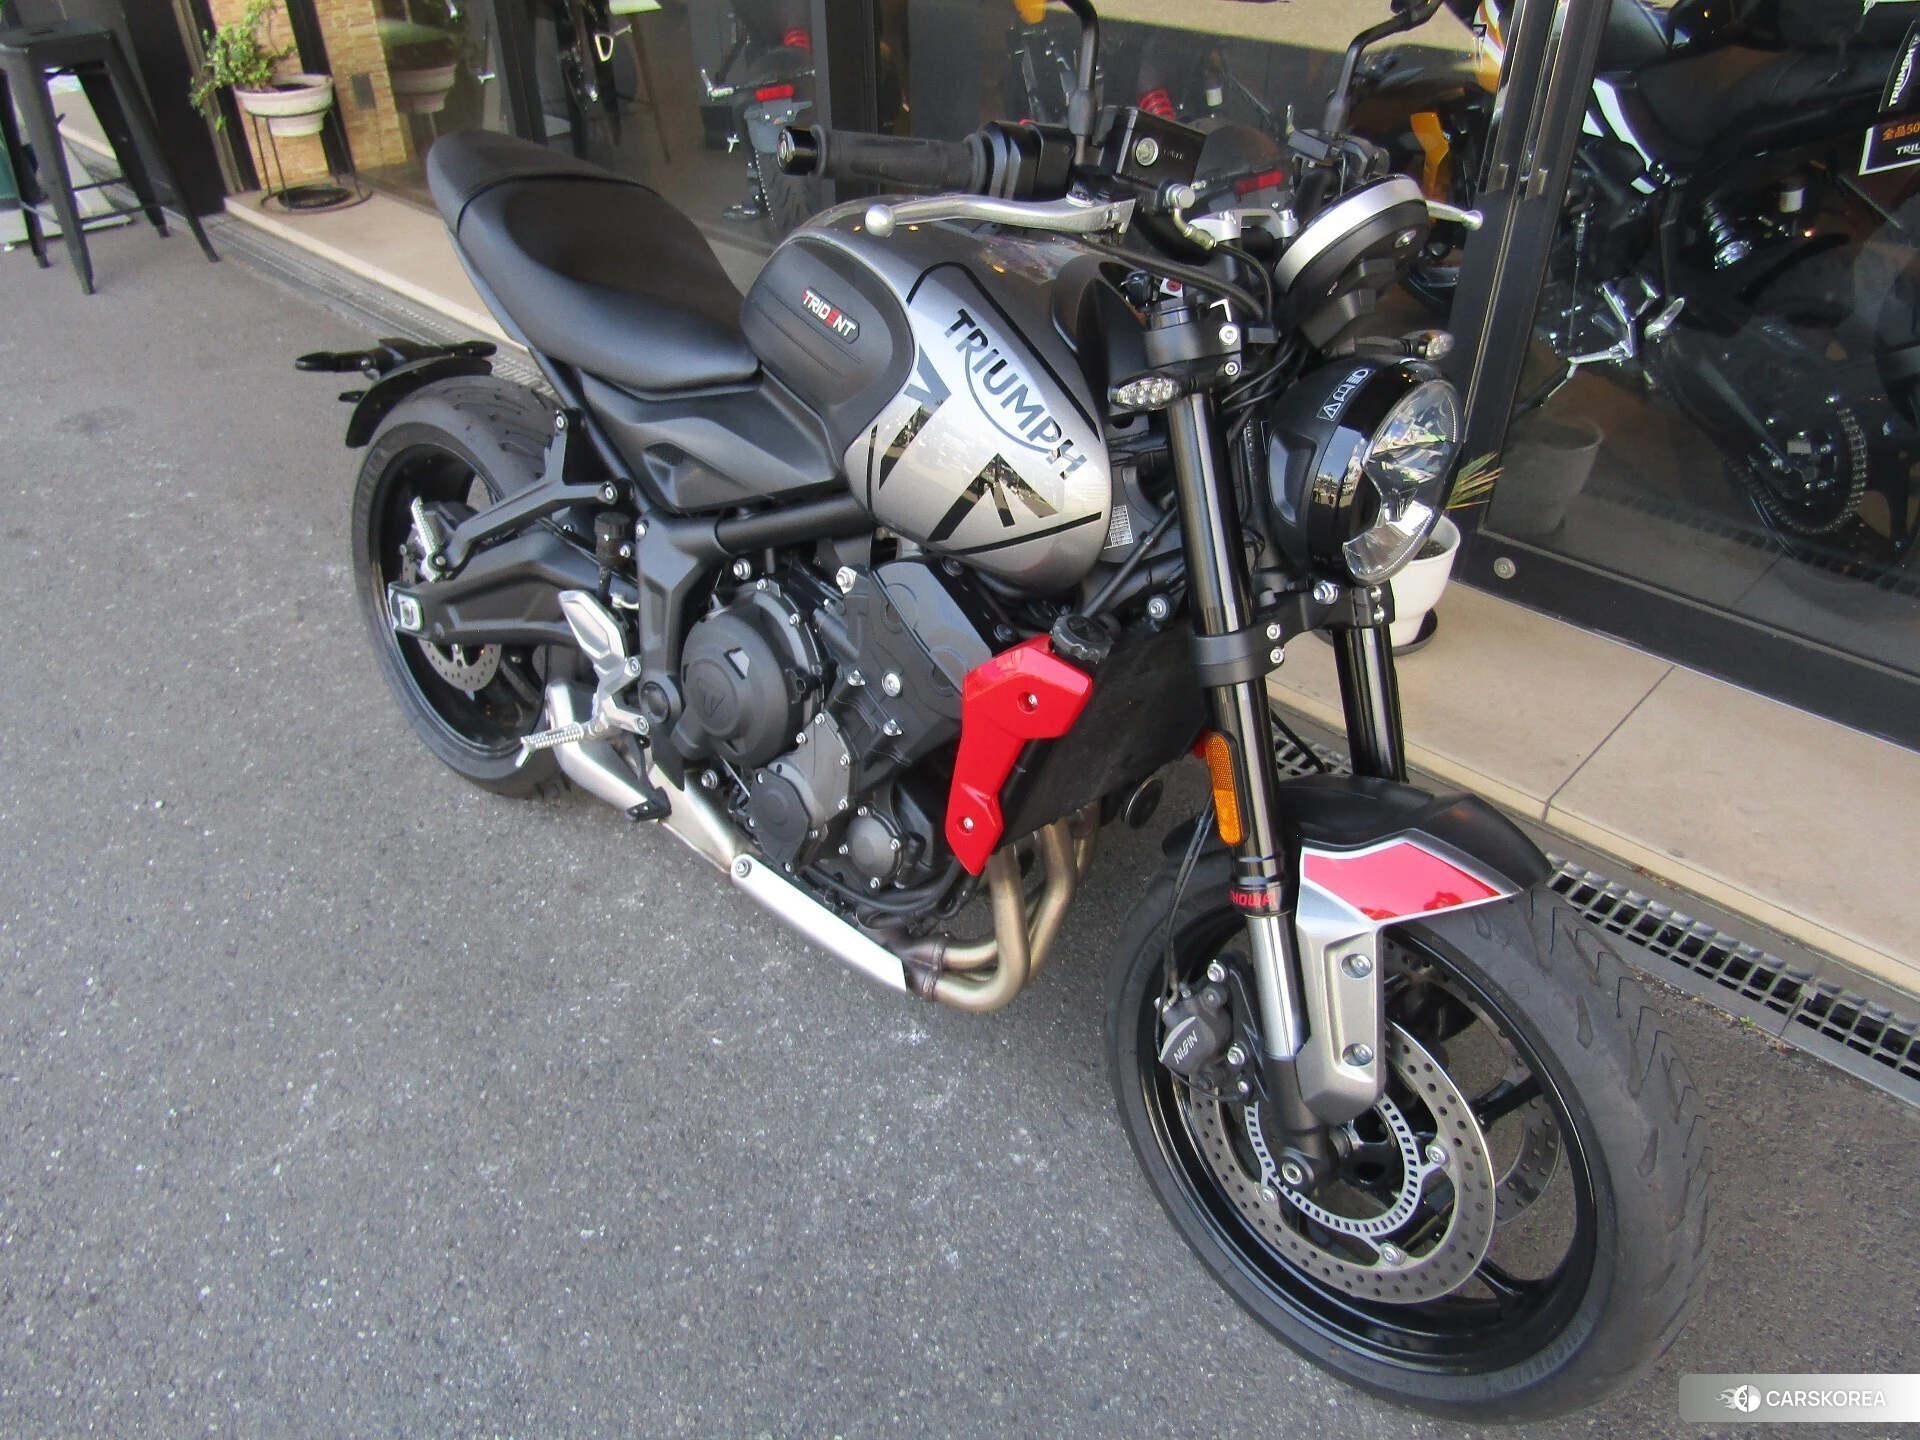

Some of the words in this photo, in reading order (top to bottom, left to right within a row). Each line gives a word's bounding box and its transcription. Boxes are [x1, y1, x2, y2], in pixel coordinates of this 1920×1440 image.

[803, 290, 857, 337] TRIDENT
[944, 308, 1087, 480] TRIUMPH
[1173, 1030, 1198, 1064] NISSIN
